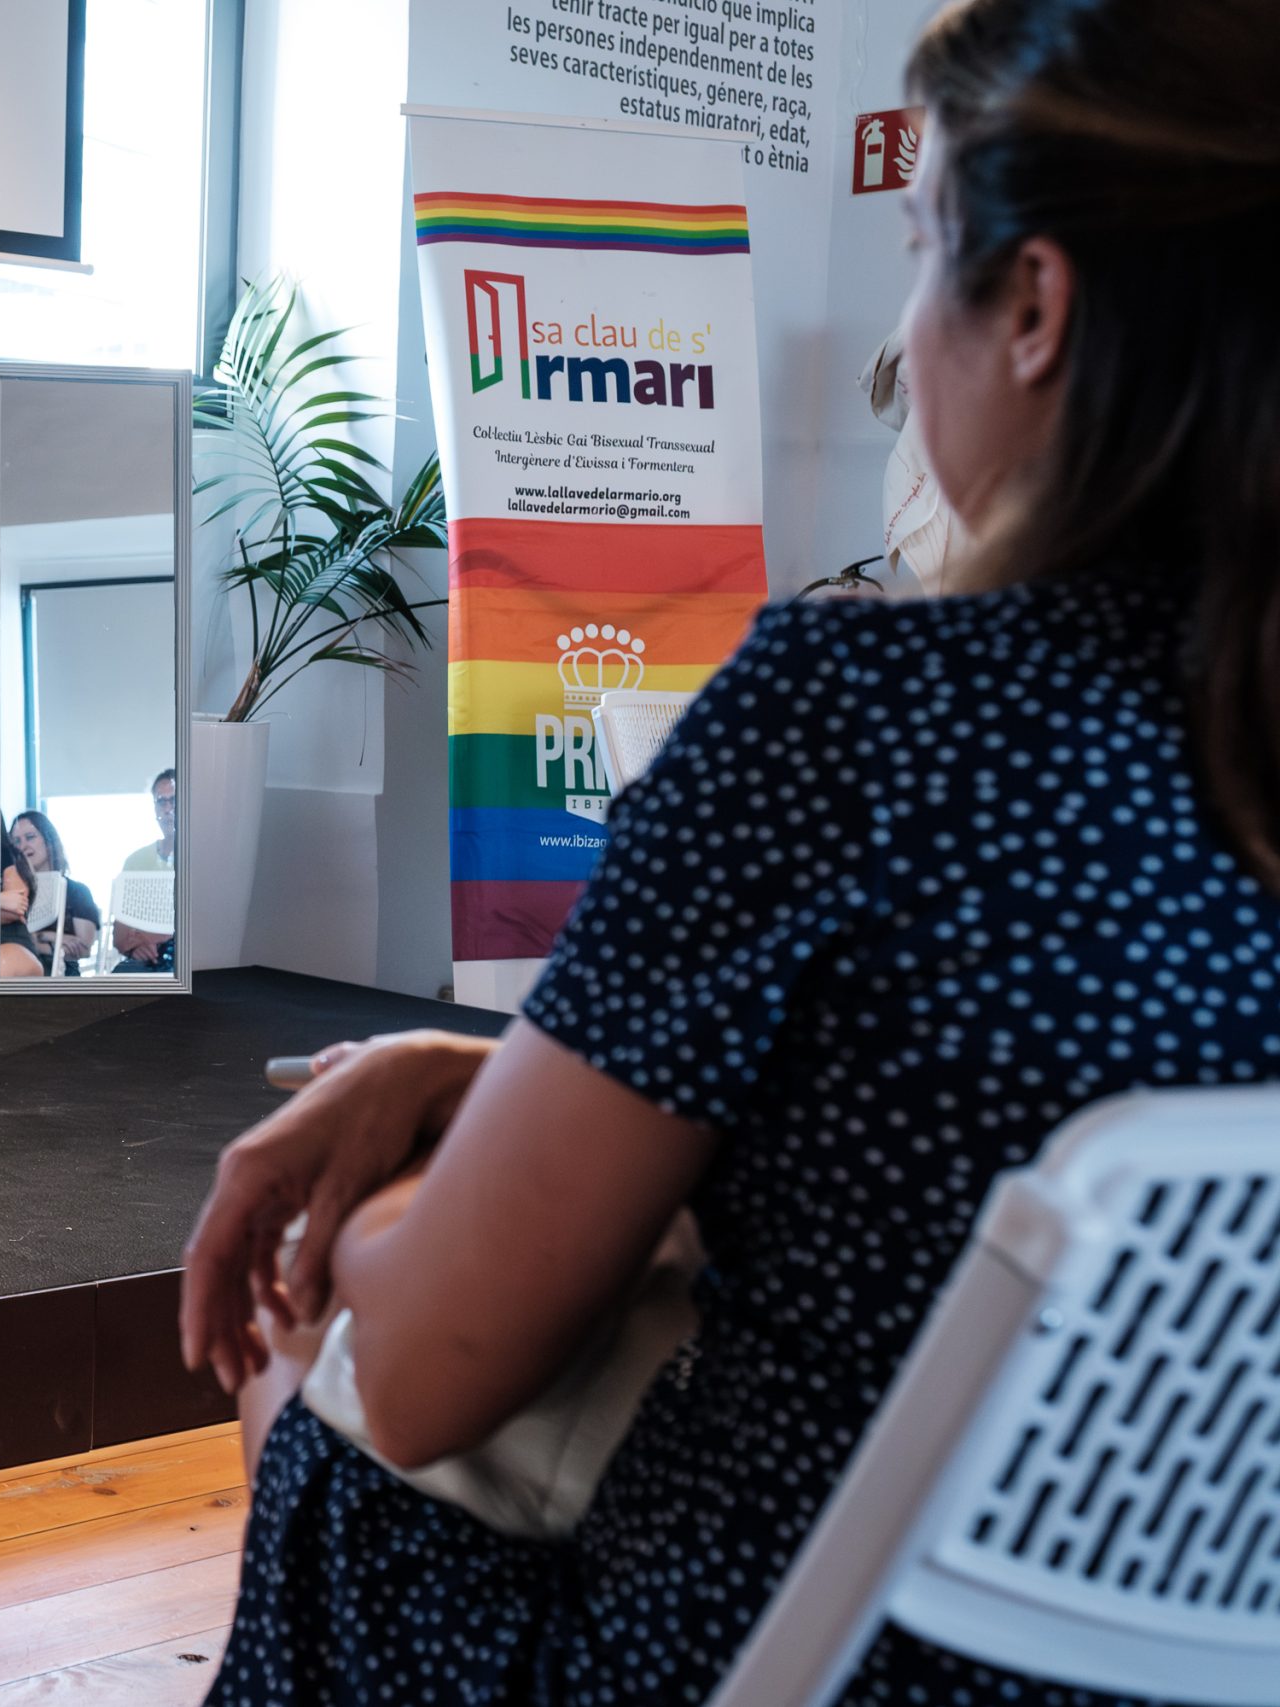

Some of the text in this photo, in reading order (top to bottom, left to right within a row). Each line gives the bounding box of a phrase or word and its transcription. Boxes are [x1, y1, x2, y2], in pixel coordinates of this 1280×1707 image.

[598, 0, 648, 29] tracte
[652, 14, 680, 36] per
[684, 15, 725, 44] igual
[729, 30, 756, 51] per
[759, 36, 769, 53] a
[774, 36, 814, 61] totes
[722, 0, 752, 22] que
[756, 2, 815, 33] implica
[507, 6, 813, 89] les persones independenment de les
[510, 44, 558, 70] seves
[563, 55, 702, 101] característiques,
[772, 94, 811, 120] raça,
[620, 96, 680, 123] estatus
[769, 120, 810, 148] edat,
[754, 149, 764, 166] o
[768, 144, 809, 173] ètnia
[532, 321, 563, 345] sa
[574, 313, 637, 348] clau
[648, 318, 681, 352] de
[567, 433, 588, 447] Gai
[590, 434, 644, 448] Bisexual
[646, 436, 715, 453] Transsexual
[628, 457, 695, 474] Formentera
[508, 498, 690, 519] lallavedelarmario@gmail.com
[515, 485, 681, 506] www.lallavedelarmario.org
[571, 799, 603, 809] IBI
[539, 835, 607, 850] www.ibizag
